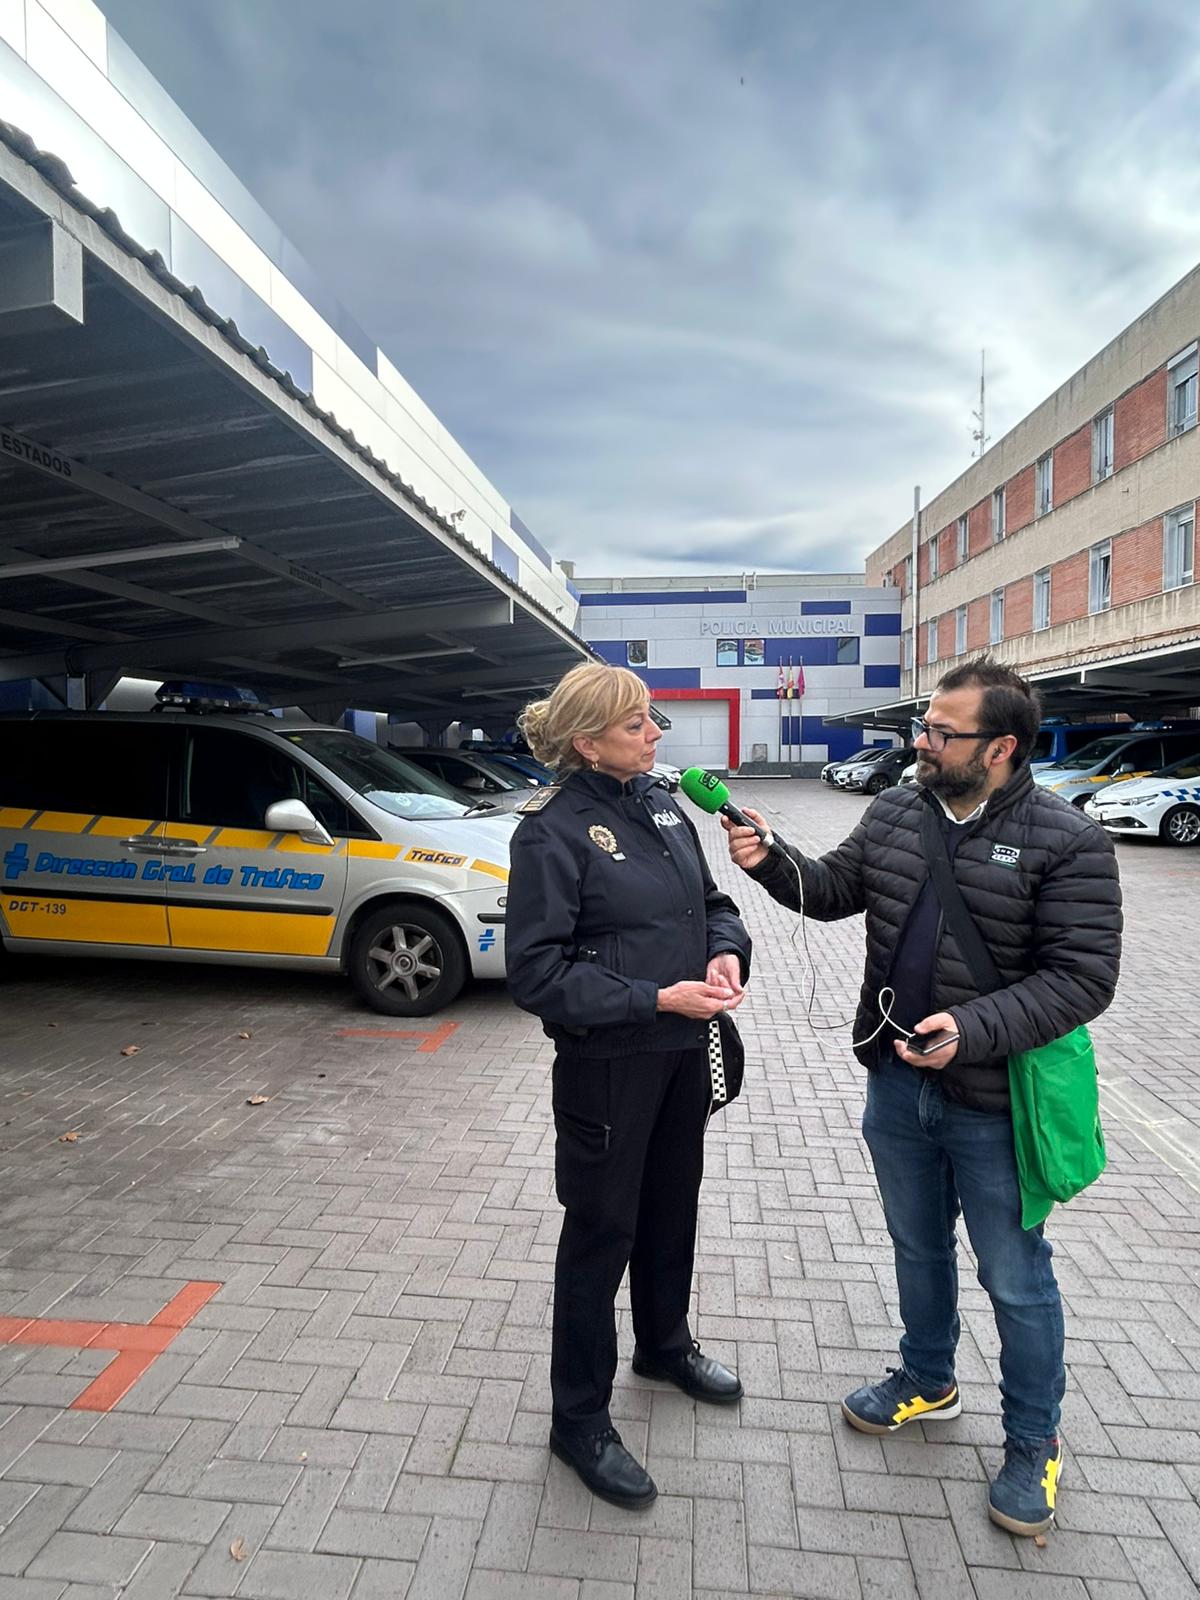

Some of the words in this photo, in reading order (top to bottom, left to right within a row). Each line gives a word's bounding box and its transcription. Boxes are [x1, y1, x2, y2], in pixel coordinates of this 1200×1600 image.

[1, 432, 72, 477] ESTADOS
[767, 618, 855, 635] MUNICIPAL
[34, 852, 138, 880] Dirección
[203, 864, 234, 885] de
